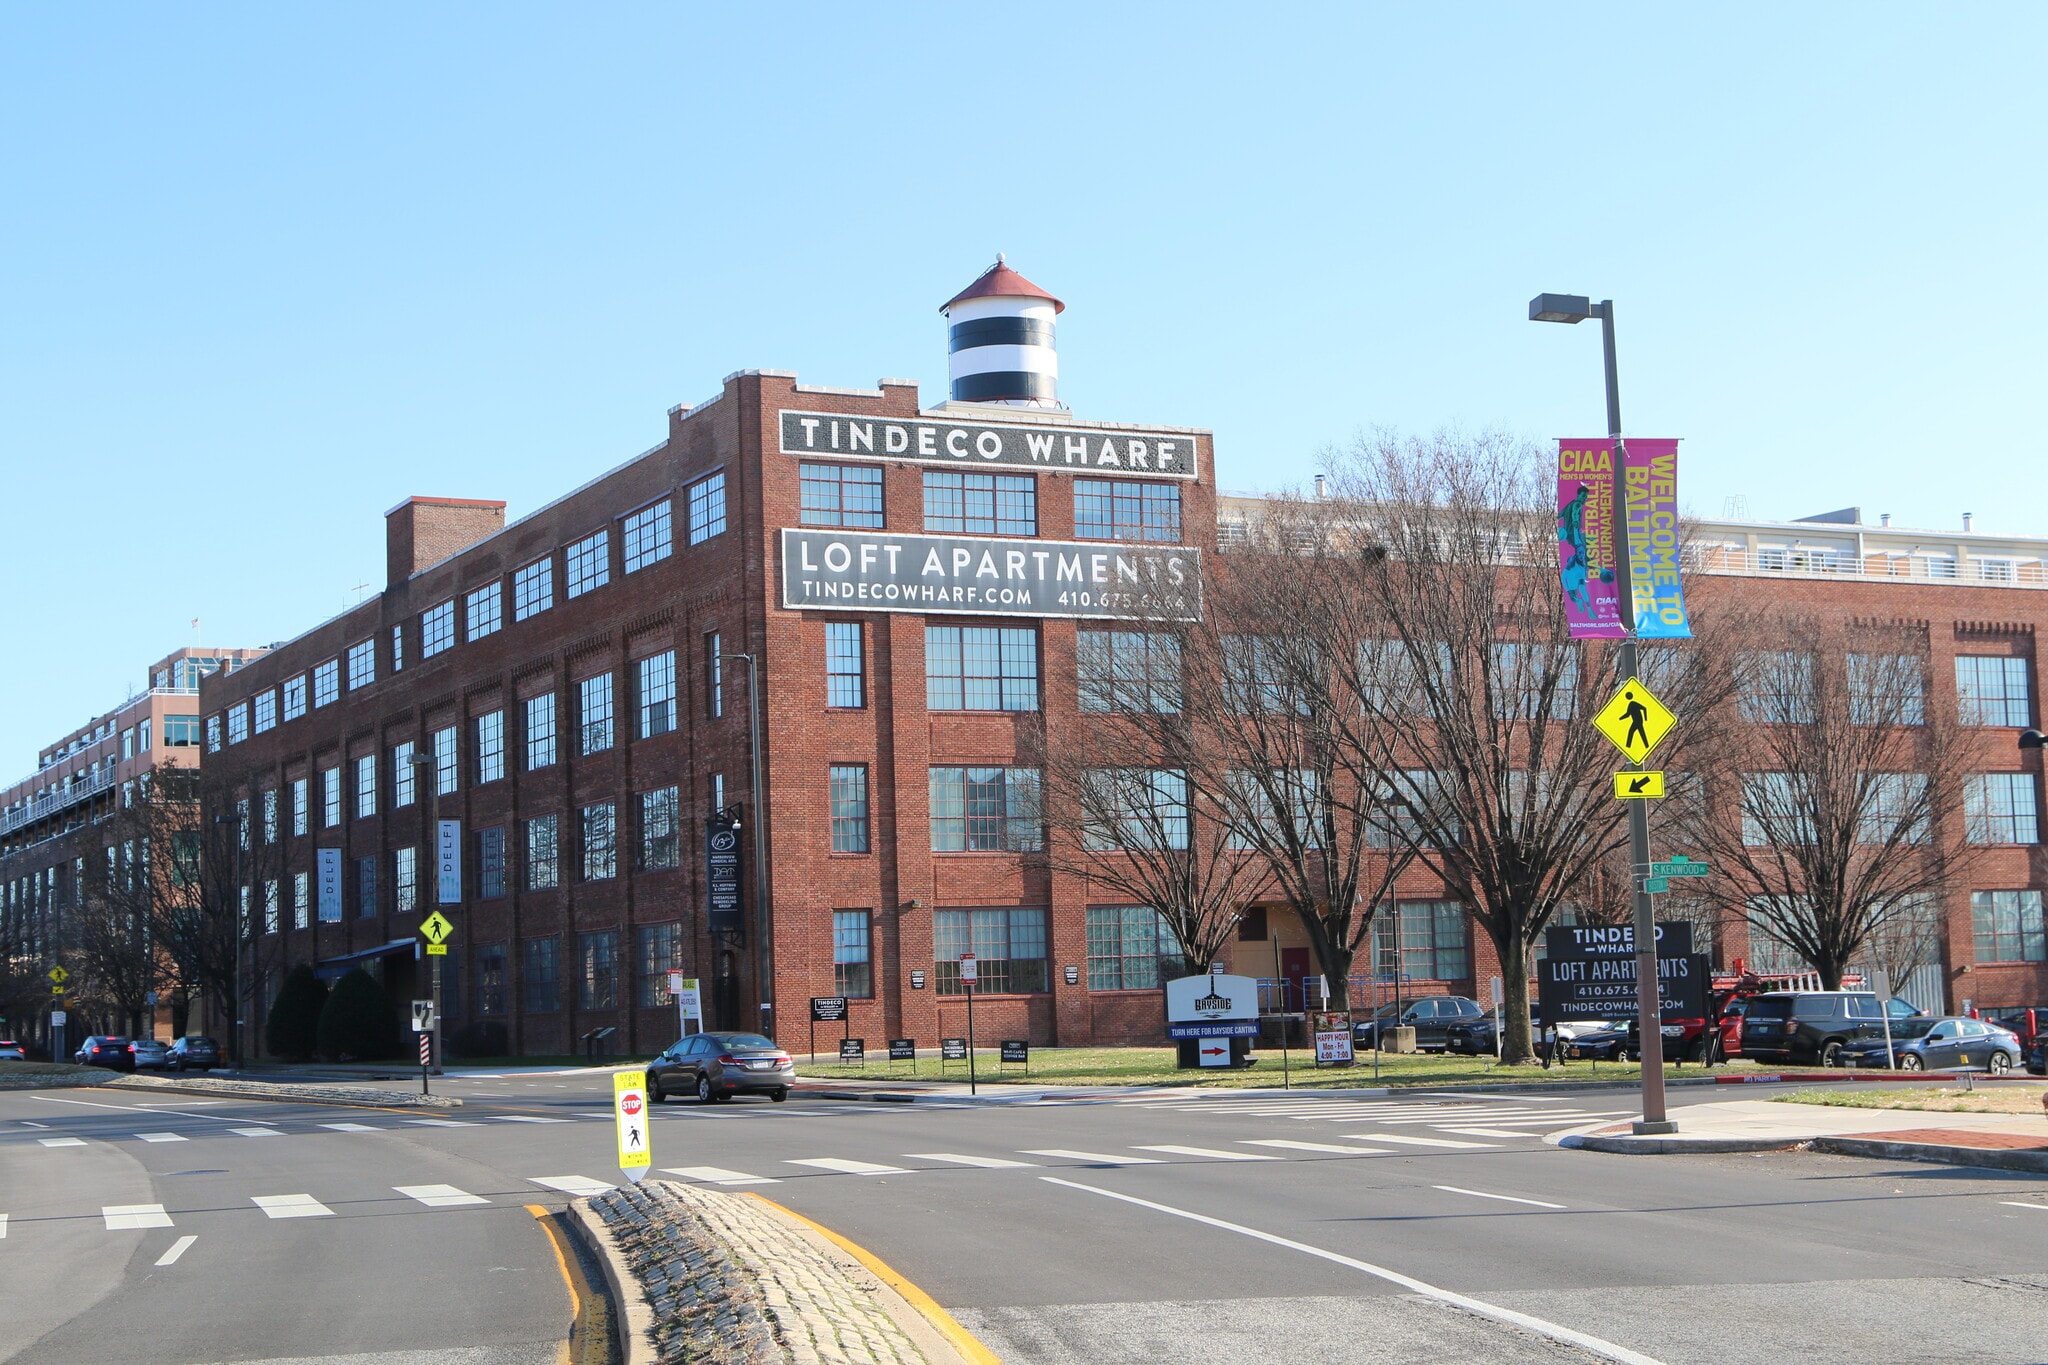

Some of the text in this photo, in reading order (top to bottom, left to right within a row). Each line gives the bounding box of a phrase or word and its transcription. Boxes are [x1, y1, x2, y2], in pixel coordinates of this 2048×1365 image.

[800, 418, 1176, 469] TINDECO WHARF
[1560, 450, 1612, 472] CIAA
[1585, 481, 1600, 579] BASKETBALL
[1600, 482, 1614, 569] TOURNAMENT
[1625, 466, 1658, 614] BALTIMORE
[1650, 454, 1684, 626] WELCOME TO
[801, 541, 1184, 586] LOFT APARTMENTS
[802, 580, 1032, 605] TINDECOWHARF.COM
[443, 824, 452, 872] DELFI
[326, 850, 334, 894] DELFI
[1660, 864, 1699, 874] KENWOOD
[1573, 926, 1664, 944] TINDEO
[1597, 943, 1635, 953] WHAR
[1552, 957, 1688, 982] LOFT APARTNTS
[1579, 985, 1665, 996] 410.675.64
[1194, 998, 1232, 1011] BAYSIDE
[1171, 1026, 1257, 1037] TURN HERE FOR BAYSIDE CANTINA
[1334, 1033, 1349, 1041] HOUR
[1322, 1042, 1333, 1050] Mon
[622, 1101, 641, 1110] STOP
